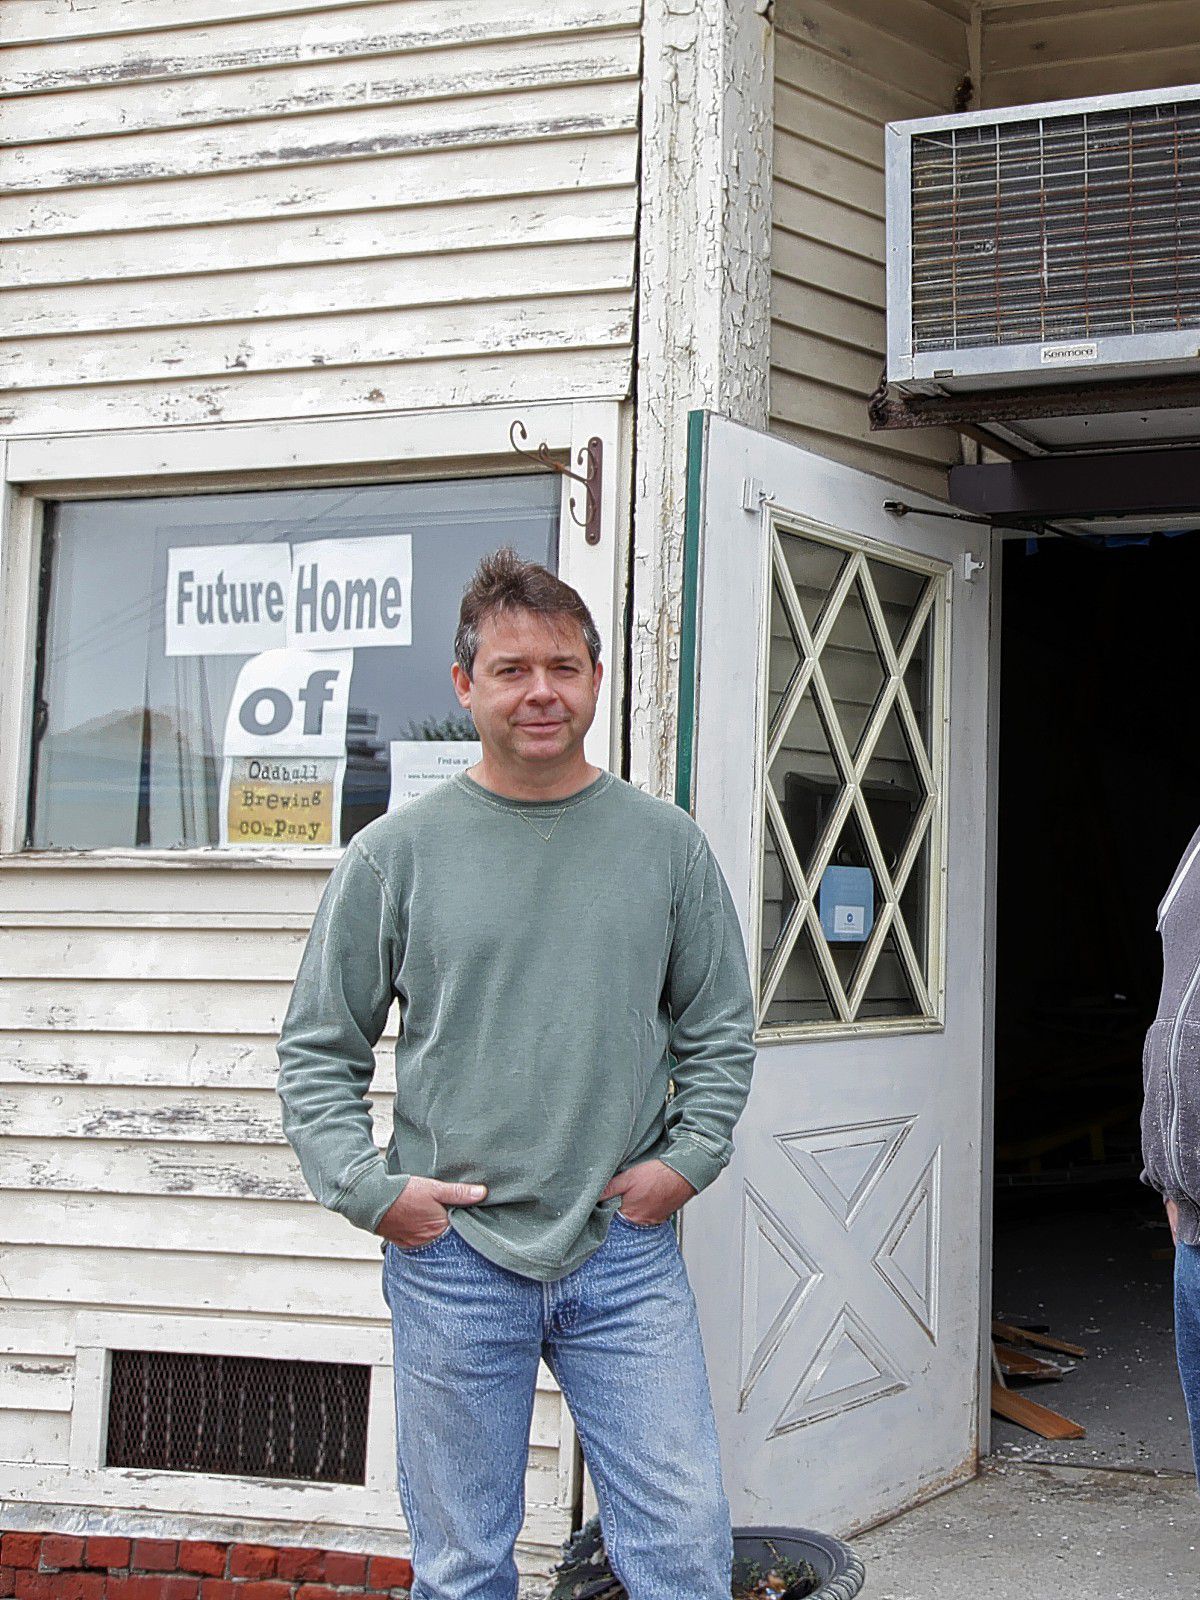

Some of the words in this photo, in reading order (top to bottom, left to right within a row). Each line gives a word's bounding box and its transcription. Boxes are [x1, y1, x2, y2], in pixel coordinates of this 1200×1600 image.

[1043, 348, 1093, 358] Kenmore
[176, 569, 284, 625] Future
[295, 563, 402, 633] Home
[239, 670, 340, 736] of
[249, 761, 319, 781] Oddball
[242, 790, 322, 809] Brewing
